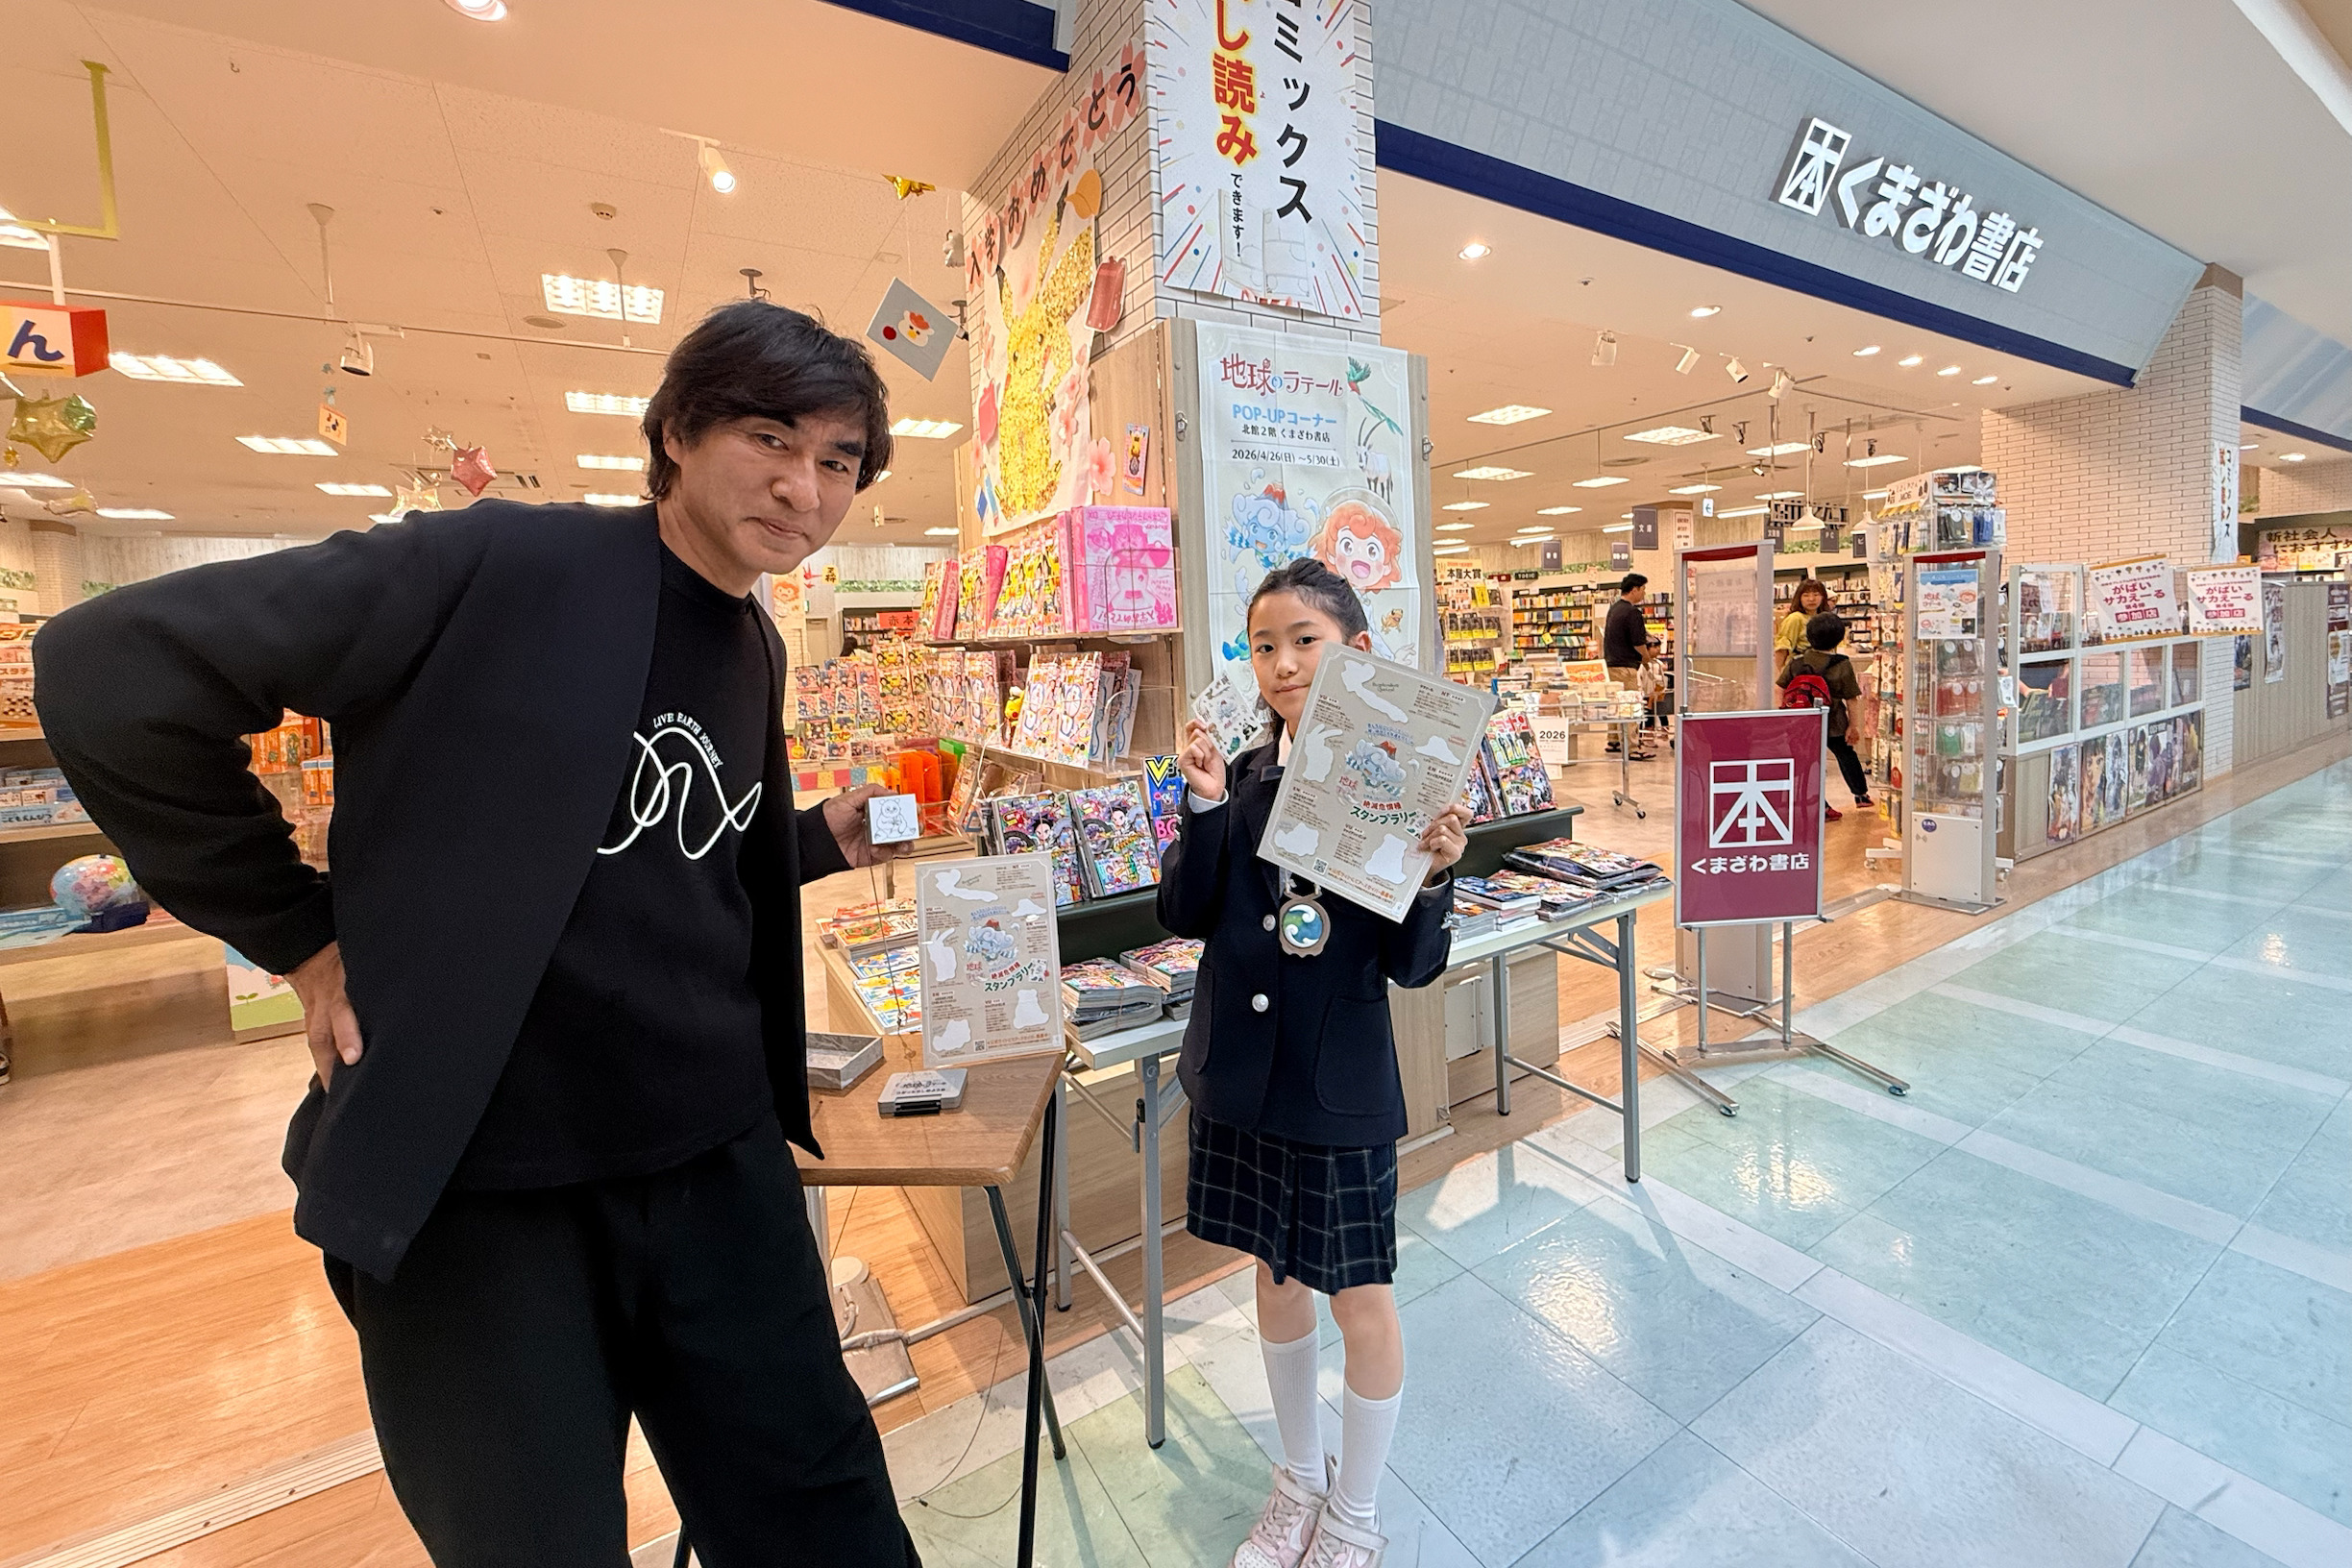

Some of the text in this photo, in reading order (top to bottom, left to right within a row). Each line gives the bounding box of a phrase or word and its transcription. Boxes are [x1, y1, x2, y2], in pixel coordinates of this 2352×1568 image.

[1213, 0, 1257, 165] し読み
[1274, 0, 1313, 225] ミックス
[968, 62, 1137, 284] 入学おめでとう
[1837, 156, 2044, 294] くまざわ書店
[1219, 353, 1344, 397] 地球のラテール
[1232, 404, 1337, 428] POP-UPコーナー
[1280, 429, 1331, 443] くまざわ書店
[2266, 527, 2338, 542] 新社会人
[1447, 568, 1482, 579] 本屋大賞
[2103, 589, 2166, 605] サカえーる
[2112, 581, 2151, 595] がばい
[2206, 585, 2242, 595] がばい
[888, 615, 913, 625] 赤本
[652, 711, 723, 769] LIVE EARTH JOURNEY
[1539, 730, 1566, 740] 2026
[1349, 805, 1417, 825] スタンプラリー
[1691, 852, 1809, 875] くまざわ書店
[984, 962, 1034, 992] スタンプラリー
